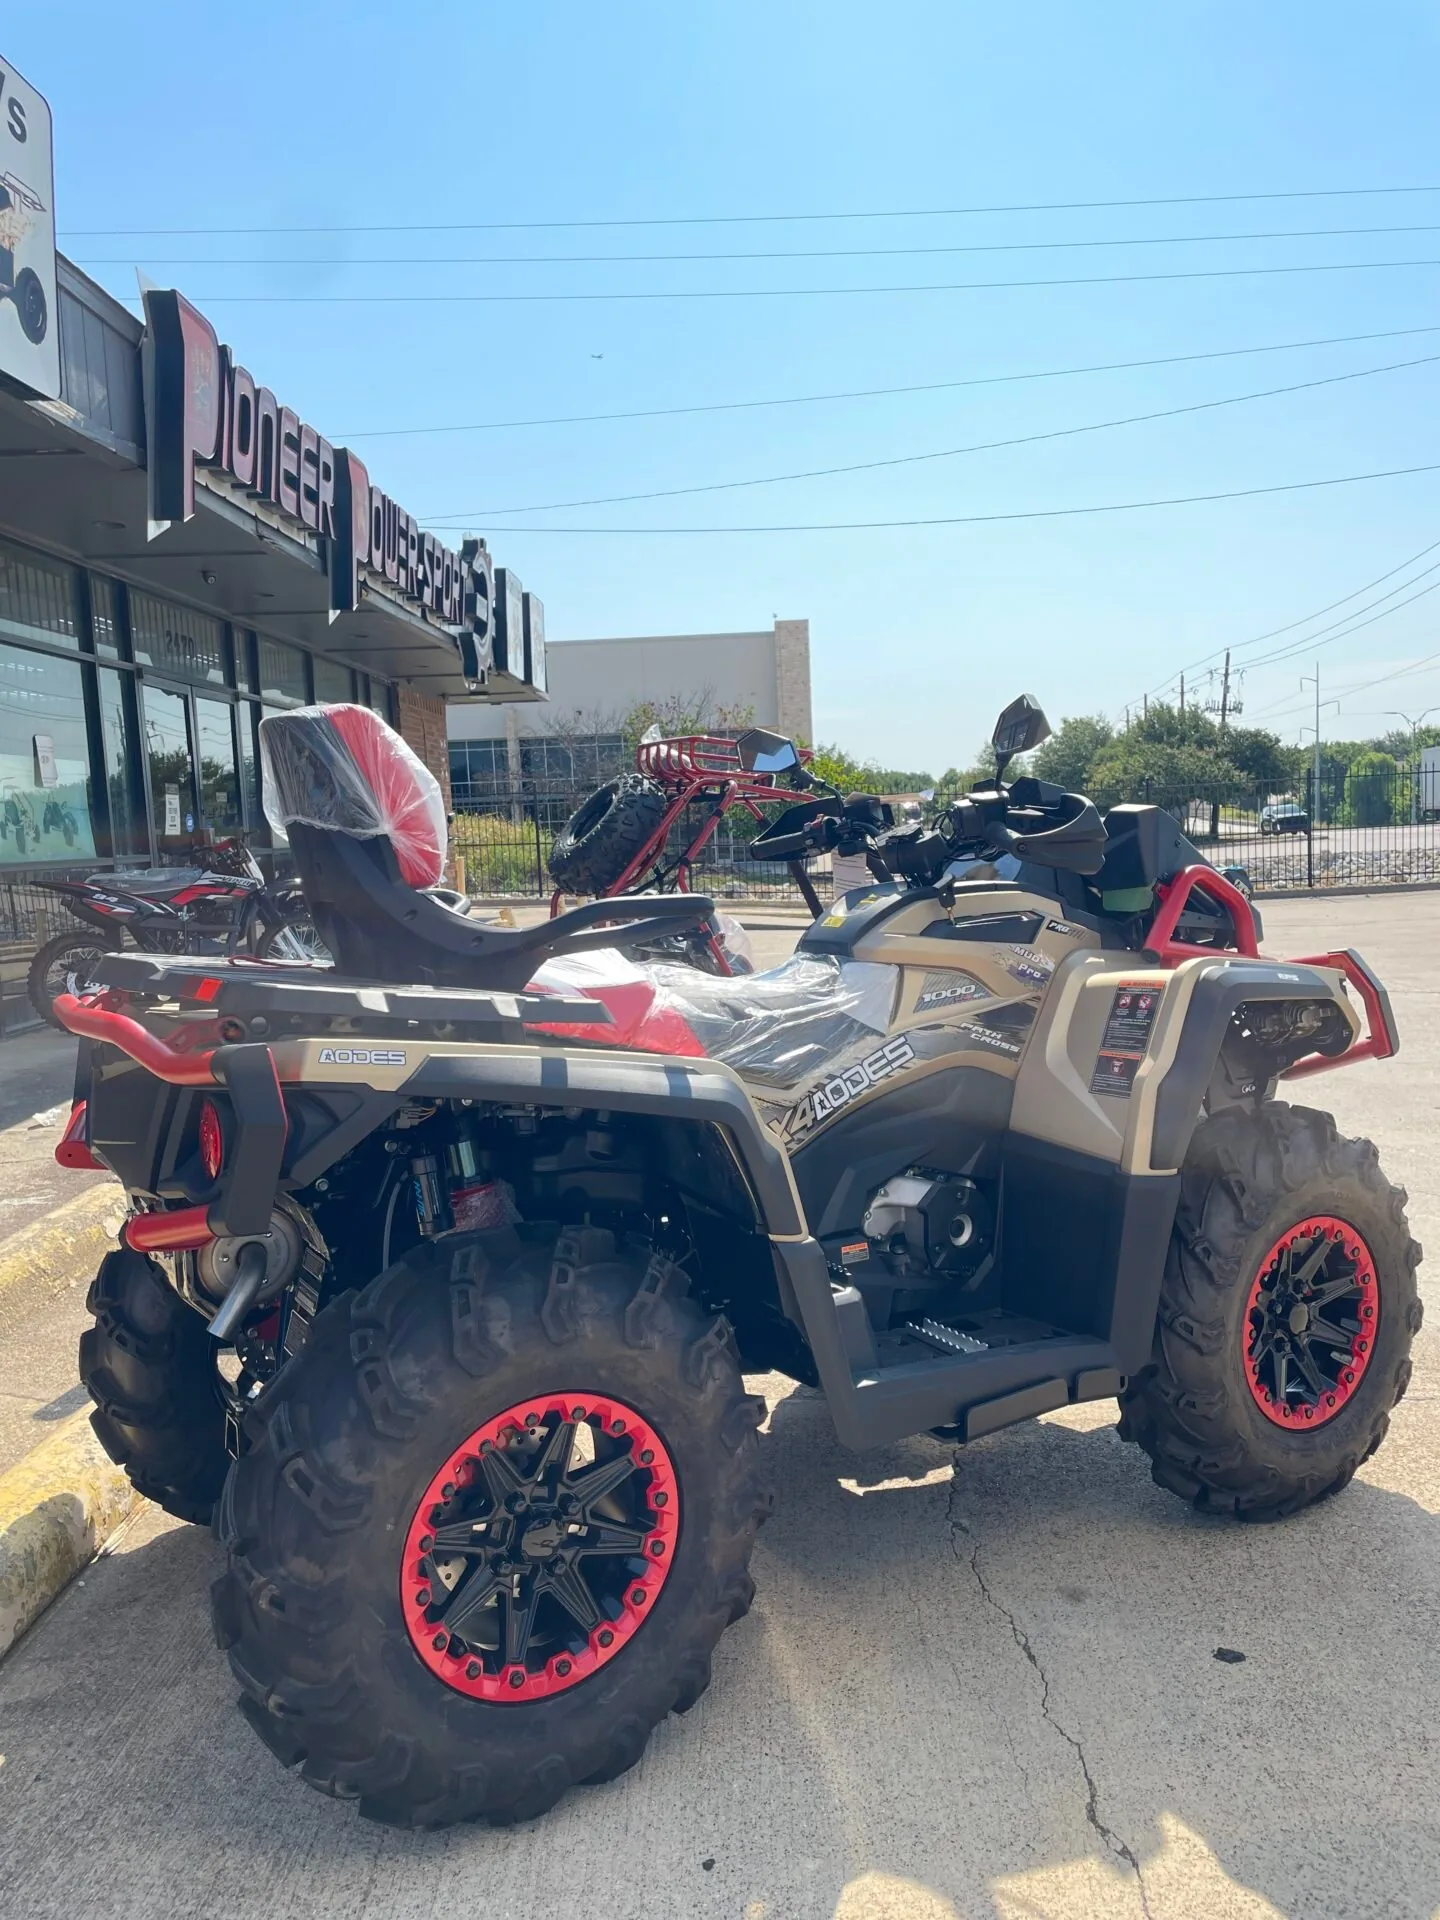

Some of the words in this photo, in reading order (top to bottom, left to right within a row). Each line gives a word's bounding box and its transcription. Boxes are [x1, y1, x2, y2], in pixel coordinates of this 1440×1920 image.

[172, 290, 337, 541] PIONEER
[1049, 921, 1070, 933] PRO
[1013, 945, 1042, 964] MUD
[1018, 962, 1042, 979] Pro
[921, 984, 976, 1002] 1000
[960, 1022, 1003, 1040] PATH
[969, 1033, 1021, 1053] CROSS
[318, 1047, 407, 1066] AODES
[811, 1035, 916, 1121] AODES
